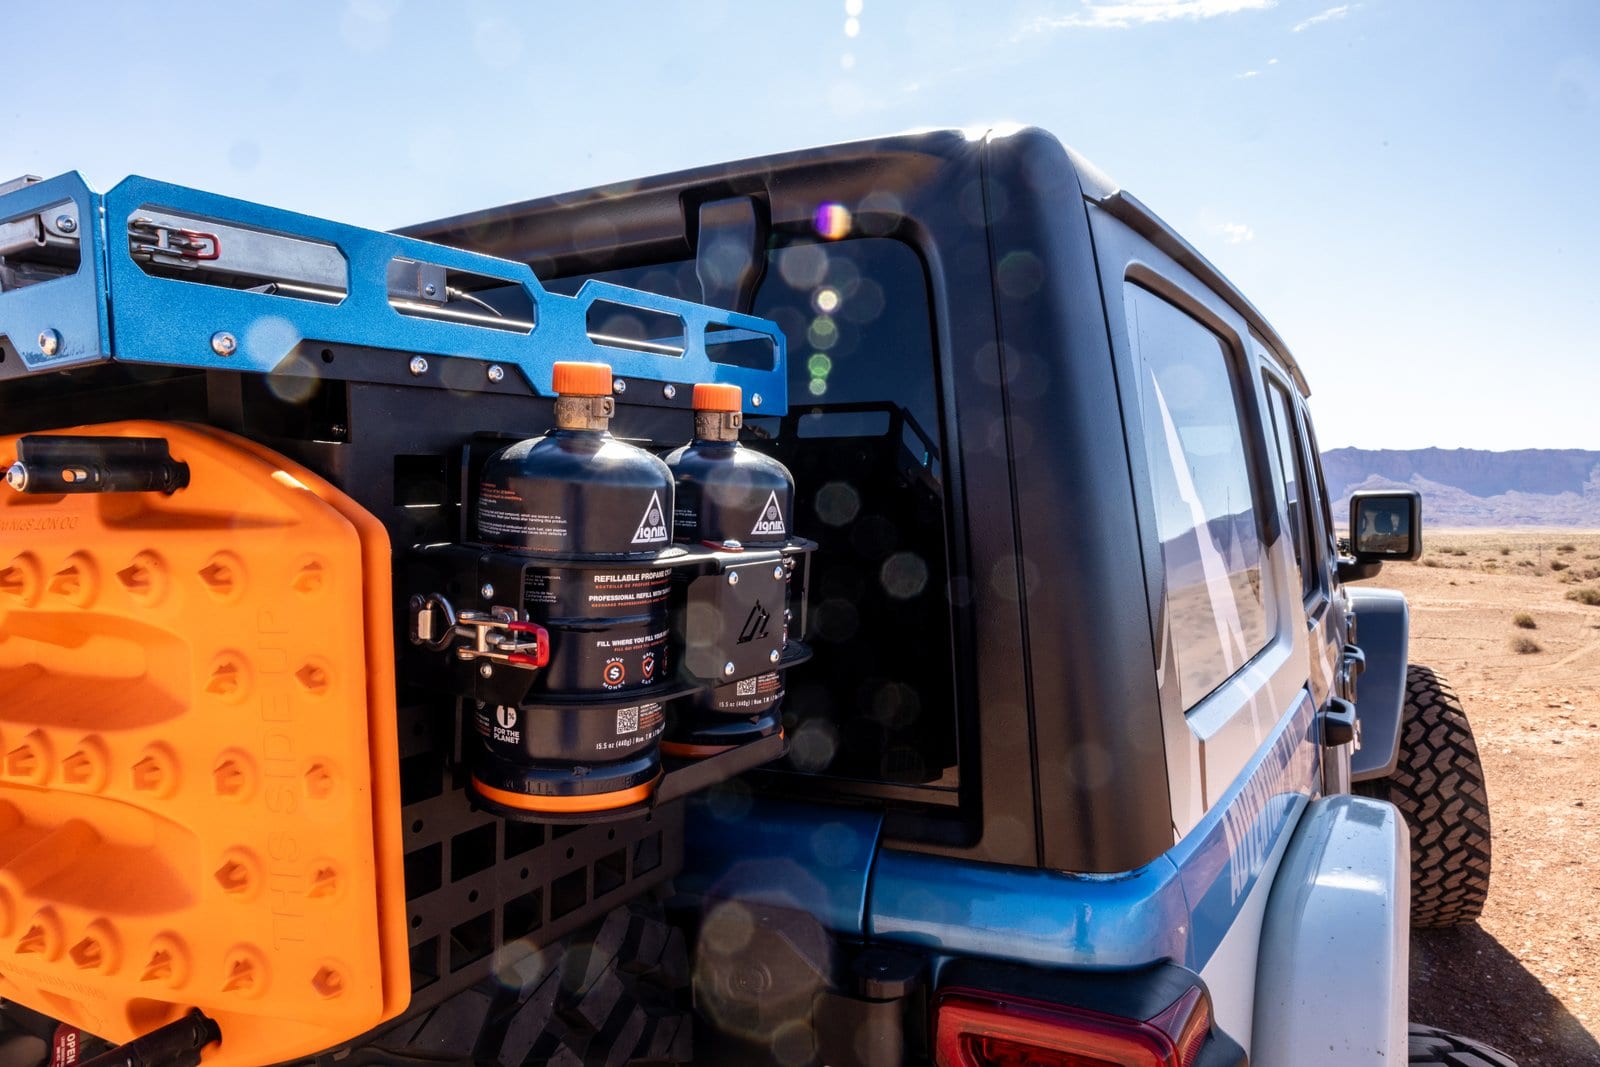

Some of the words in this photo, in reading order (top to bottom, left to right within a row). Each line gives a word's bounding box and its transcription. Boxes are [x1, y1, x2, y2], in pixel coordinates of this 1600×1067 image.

[594, 573, 640, 583] REFILLABLE
[641, 570, 664, 580] PROPANE
[588, 594, 635, 602] PROFESSIONAL
[256, 606, 290, 676] UP
[602, 680, 625, 690] MONEY
[494, 726, 505, 735] FOR
[506, 730, 520, 738] THE
[494, 733, 520, 744] PLANET
[616, 739, 632, 748] (440g)
[260, 694, 299, 816] SIDE
[266, 831, 305, 952] THIS
[66, 1033, 76, 1064] OPEN
